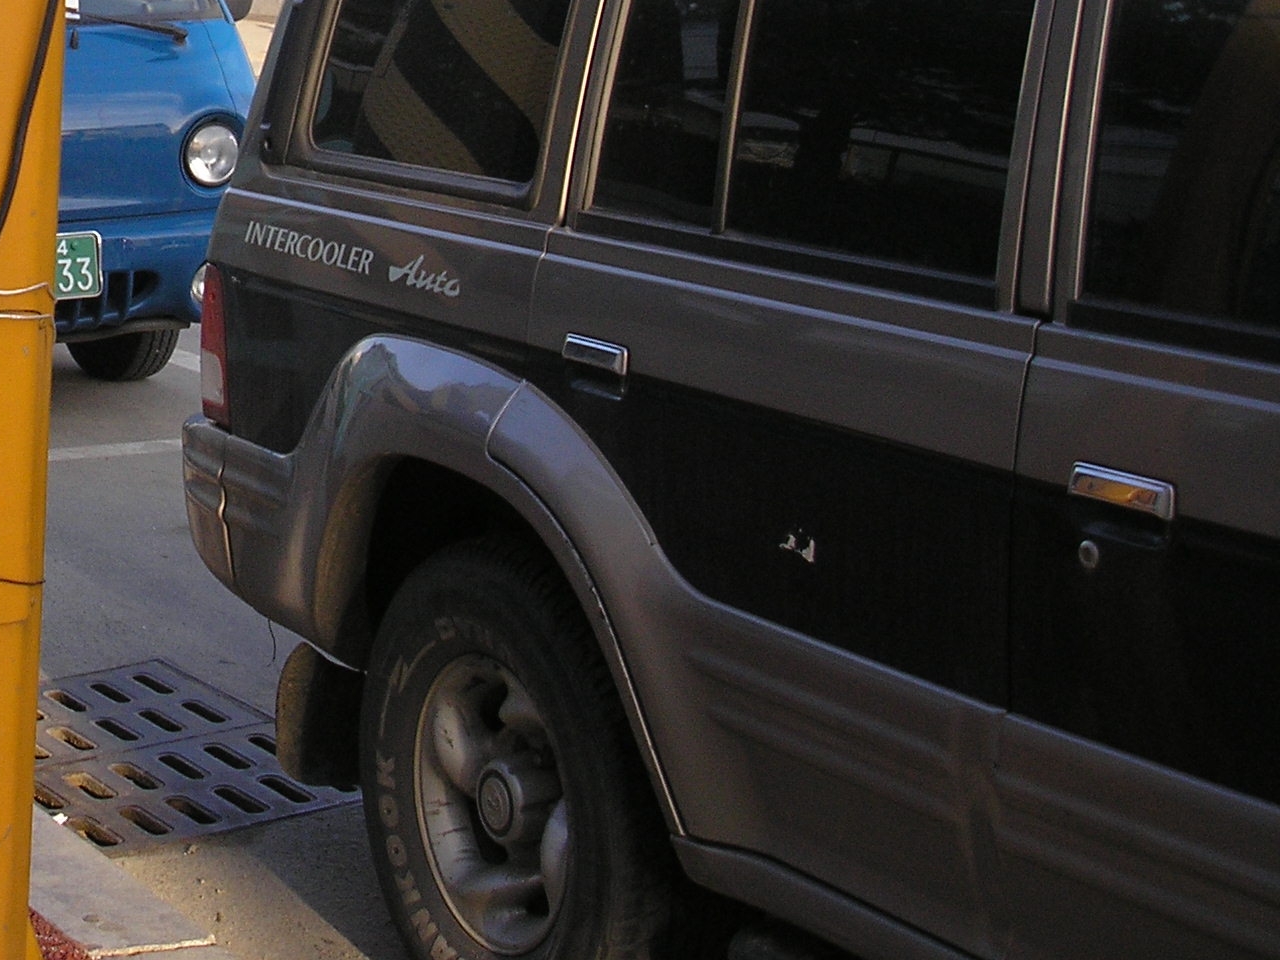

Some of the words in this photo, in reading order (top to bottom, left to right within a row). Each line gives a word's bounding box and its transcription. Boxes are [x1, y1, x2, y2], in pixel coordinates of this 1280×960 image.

[57, 239, 68, 255] 4
[58, 257, 93, 292] 33
[244, 220, 374, 275] INTERCOOLER
[388, 254, 461, 297] Auto
[375, 749, 463, 960] ANKOOK
